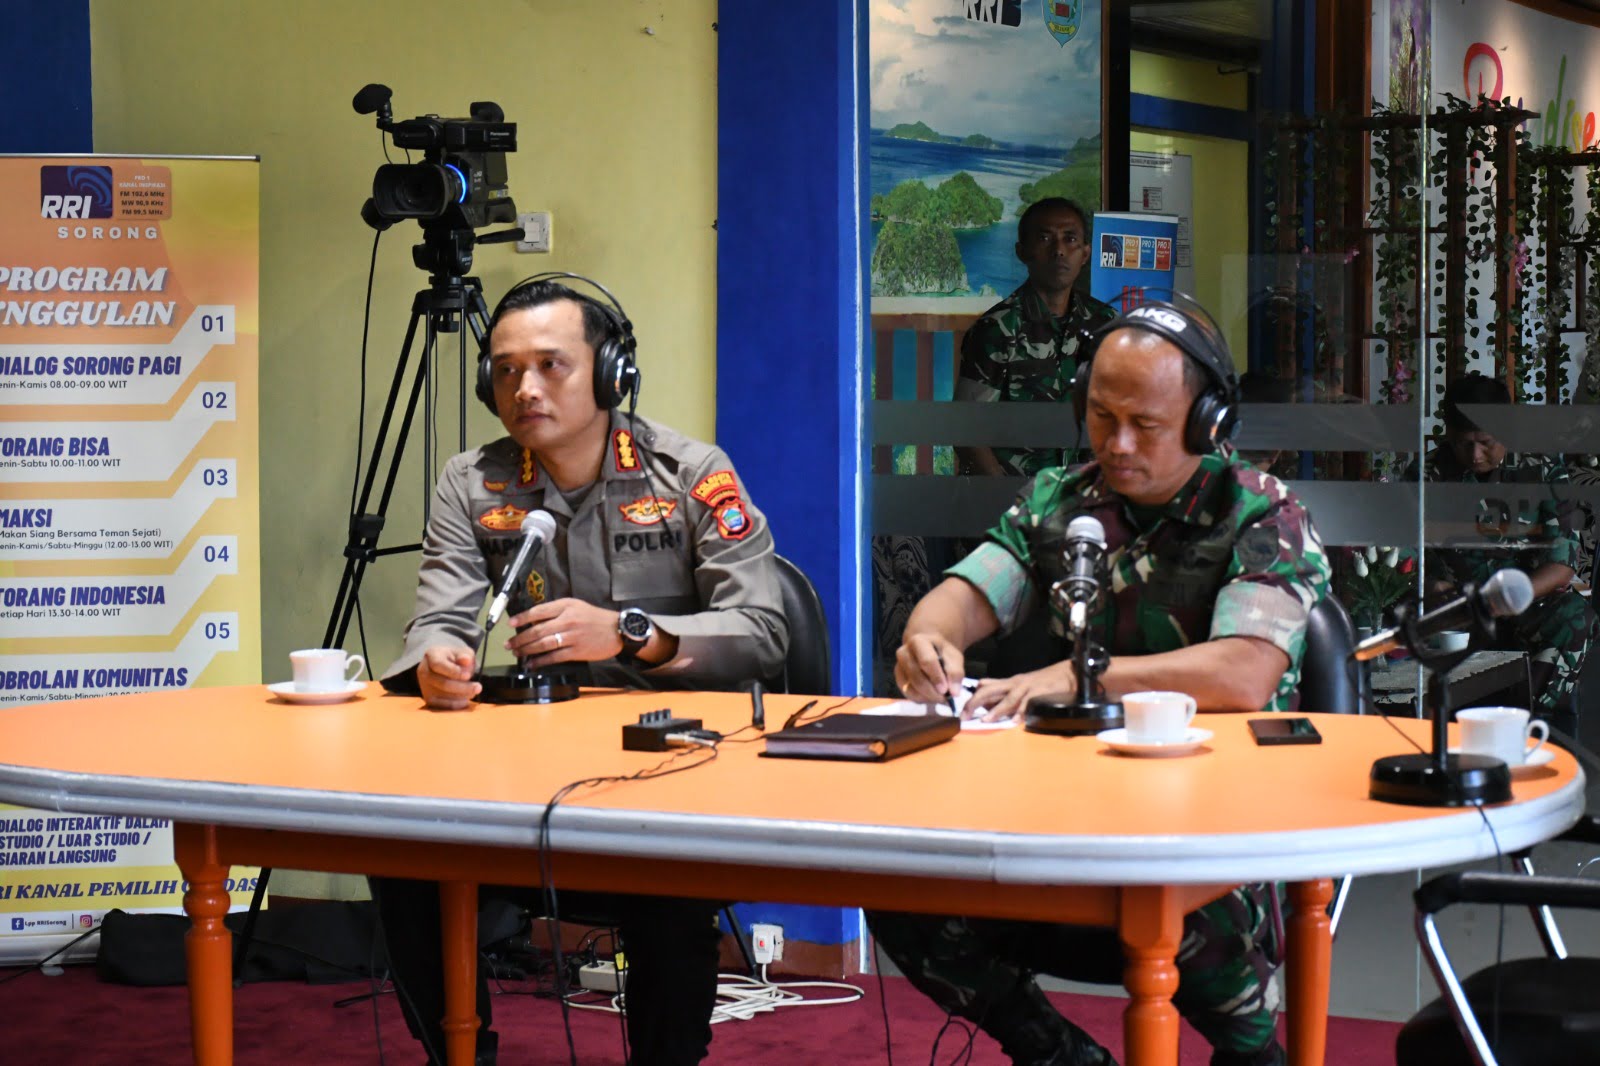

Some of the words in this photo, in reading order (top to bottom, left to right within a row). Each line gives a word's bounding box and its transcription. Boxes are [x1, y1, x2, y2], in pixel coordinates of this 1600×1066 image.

[41, 195, 93, 219] RRI
[57, 226, 158, 239] SORONG
[1102, 252, 1117, 267] RRI
[0, 300, 176, 326] NGGULAN
[1126, 307, 1187, 332] AKG
[201, 315, 224, 332] 01
[62, 356, 134, 376] SORONG
[138, 356, 182, 375] PAGI
[0, 380, 47, 389] enin-Kamis
[49, 381, 105, 389] 08.00-09.00
[108, 381, 128, 389] WIT
[202, 391, 227, 409] 02
[0, 437, 64, 457] ORANG
[68, 437, 110, 456] BISA
[0, 459, 47, 468] enin-Sabtu
[50, 459, 99, 467] 10.00-11.00
[101, 458, 121, 467] WIT
[203, 468, 228, 486] 03
[0, 508, 53, 528] MAKSI
[29, 530, 55, 540] Siang
[57, 529, 97, 538] Bersama
[99, 529, 130, 538] Teman
[132, 528, 162, 540] Sejati)
[614, 531, 683, 552] POLRI
[0, 541, 103, 551] enin-Kamis/Sabtu-Minggu
[153, 540, 174, 549] WIT)
[204, 545, 230, 562] 04
[70, 586, 166, 606] INDONESIA
[0, 609, 24, 620] etiap
[26, 609, 46, 618] Hari
[48, 608, 99, 618] 13.30-14.00
[101, 608, 121, 617] WIT
[205, 622, 230, 639] 05
[82, 667, 188, 688] KOMUNITAS
[0, 818, 43, 833] DIALOG
[46, 816, 122, 832] INTERAKTIF
[0, 834, 43, 849] STUDIO
[46, 834, 55, 848] /
[57, 833, 91, 848] LUAR
[94, 831, 141, 846] STUDIO
[143, 831, 152, 845] /
[0, 851, 46, 866] SIARAN
[48, 849, 117, 865] LANGSUNG
[15, 883, 84, 899] KANAL
[87, 880, 178, 897] PEMILIH
[181, 877, 259, 893] CDAS
